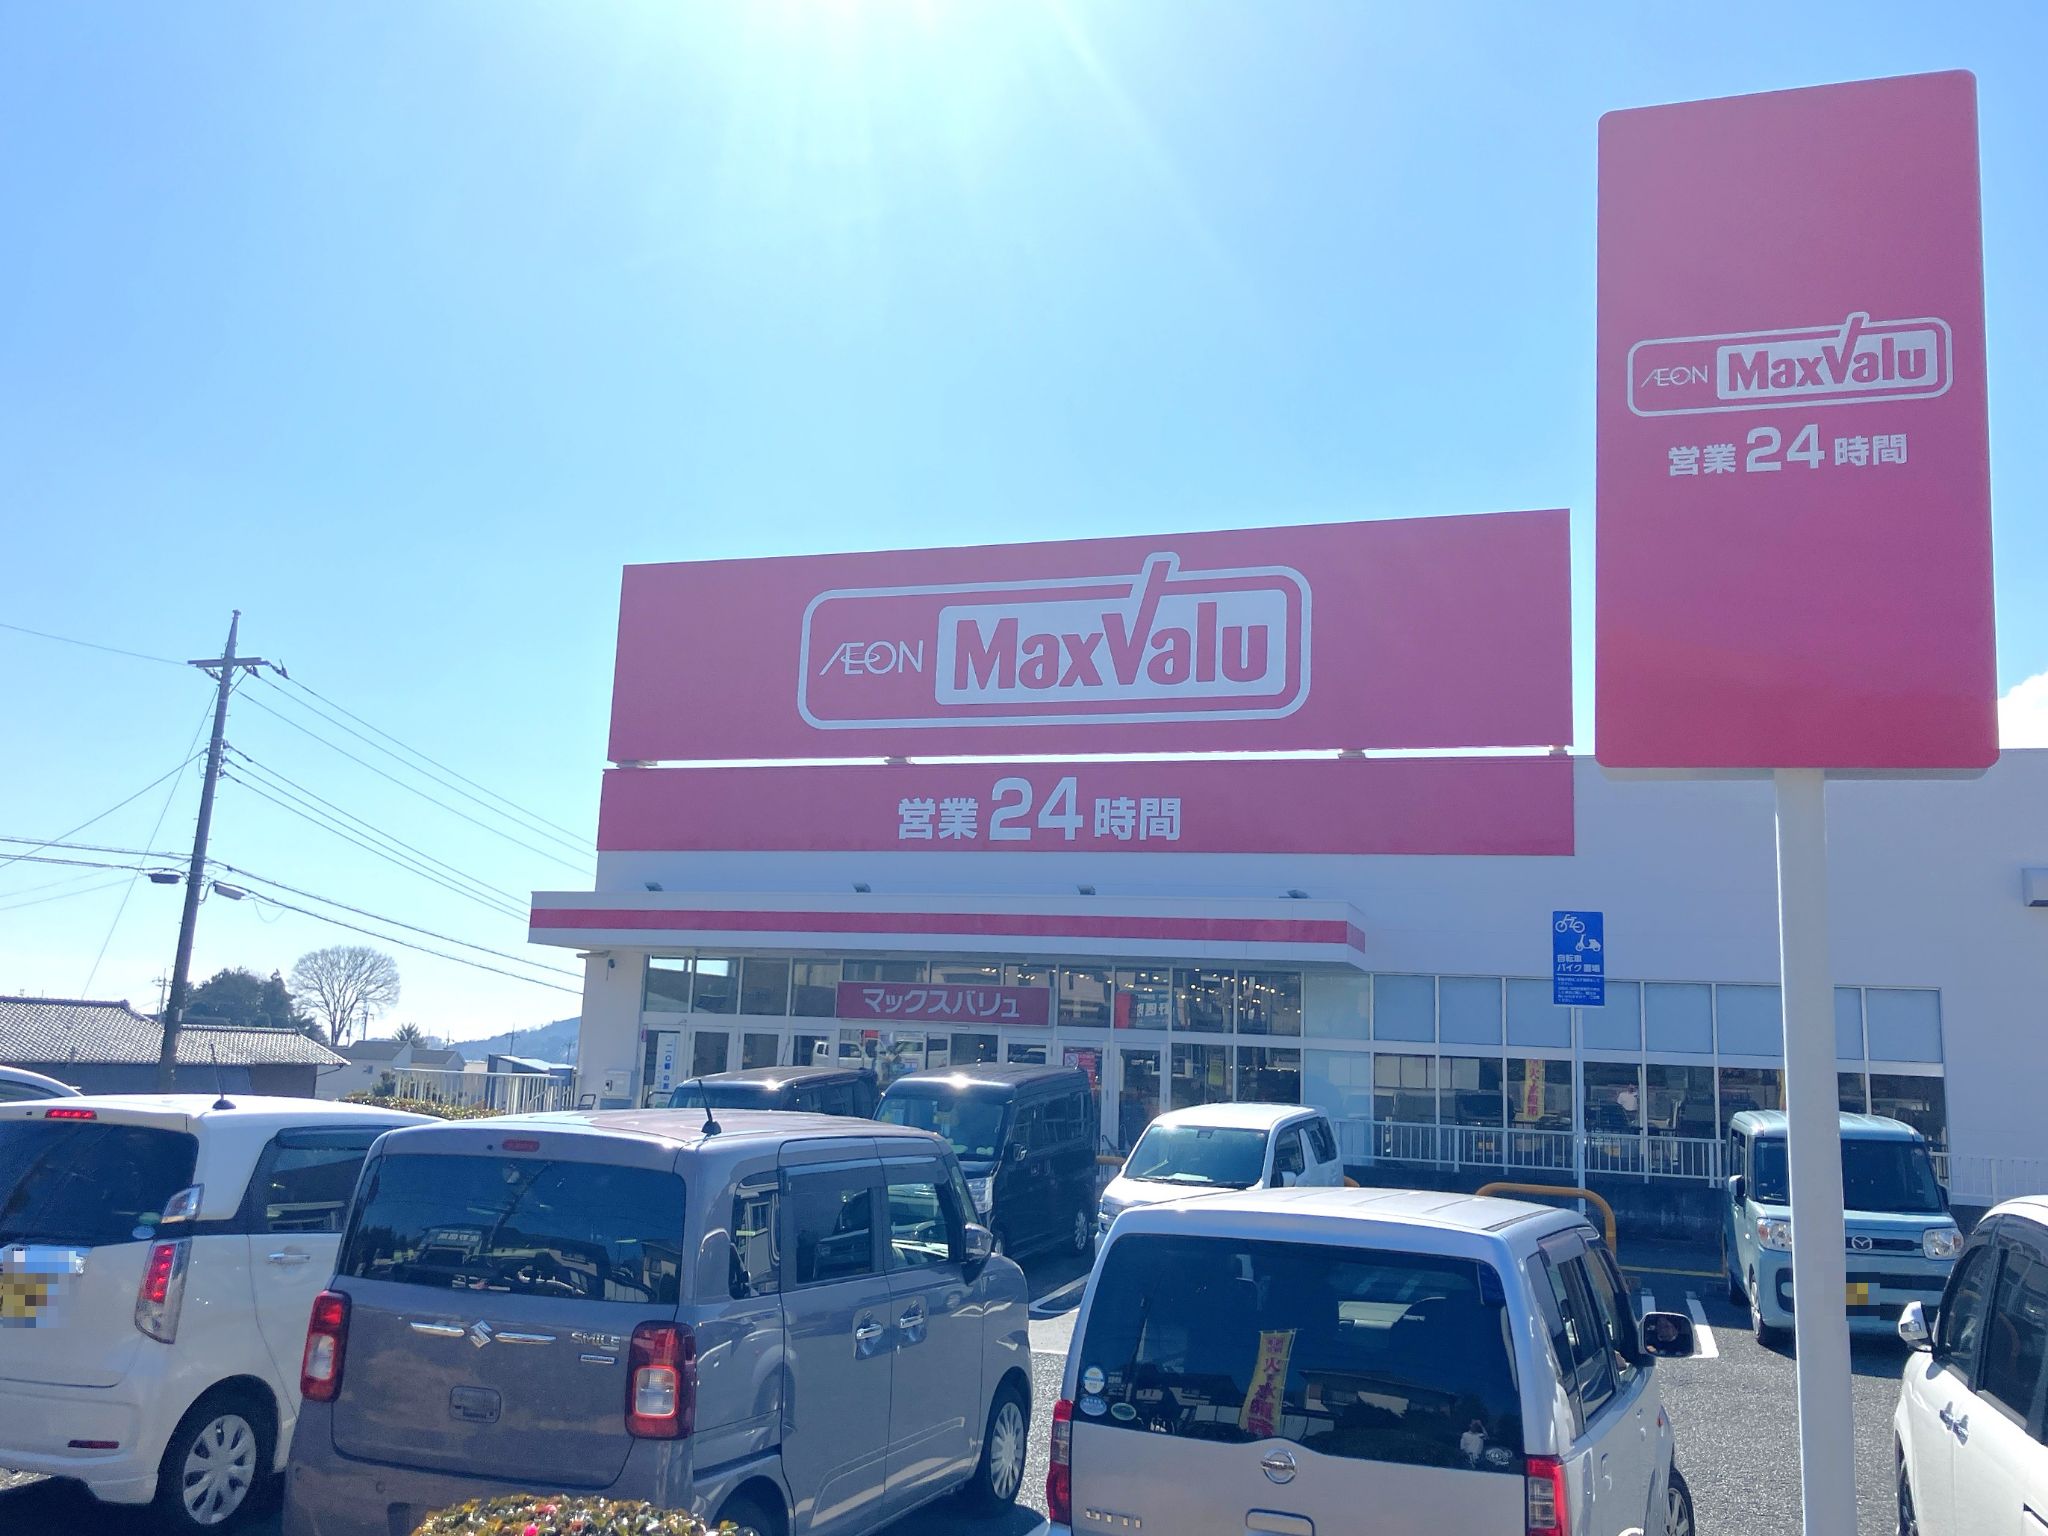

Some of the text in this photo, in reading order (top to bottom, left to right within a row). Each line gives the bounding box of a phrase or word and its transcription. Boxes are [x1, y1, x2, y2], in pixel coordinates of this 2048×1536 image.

[1728, 316, 1927, 392] MaxValu
[953, 560, 1269, 690] MaxValu
[863, 988, 1020, 1018] マックスバリュ
